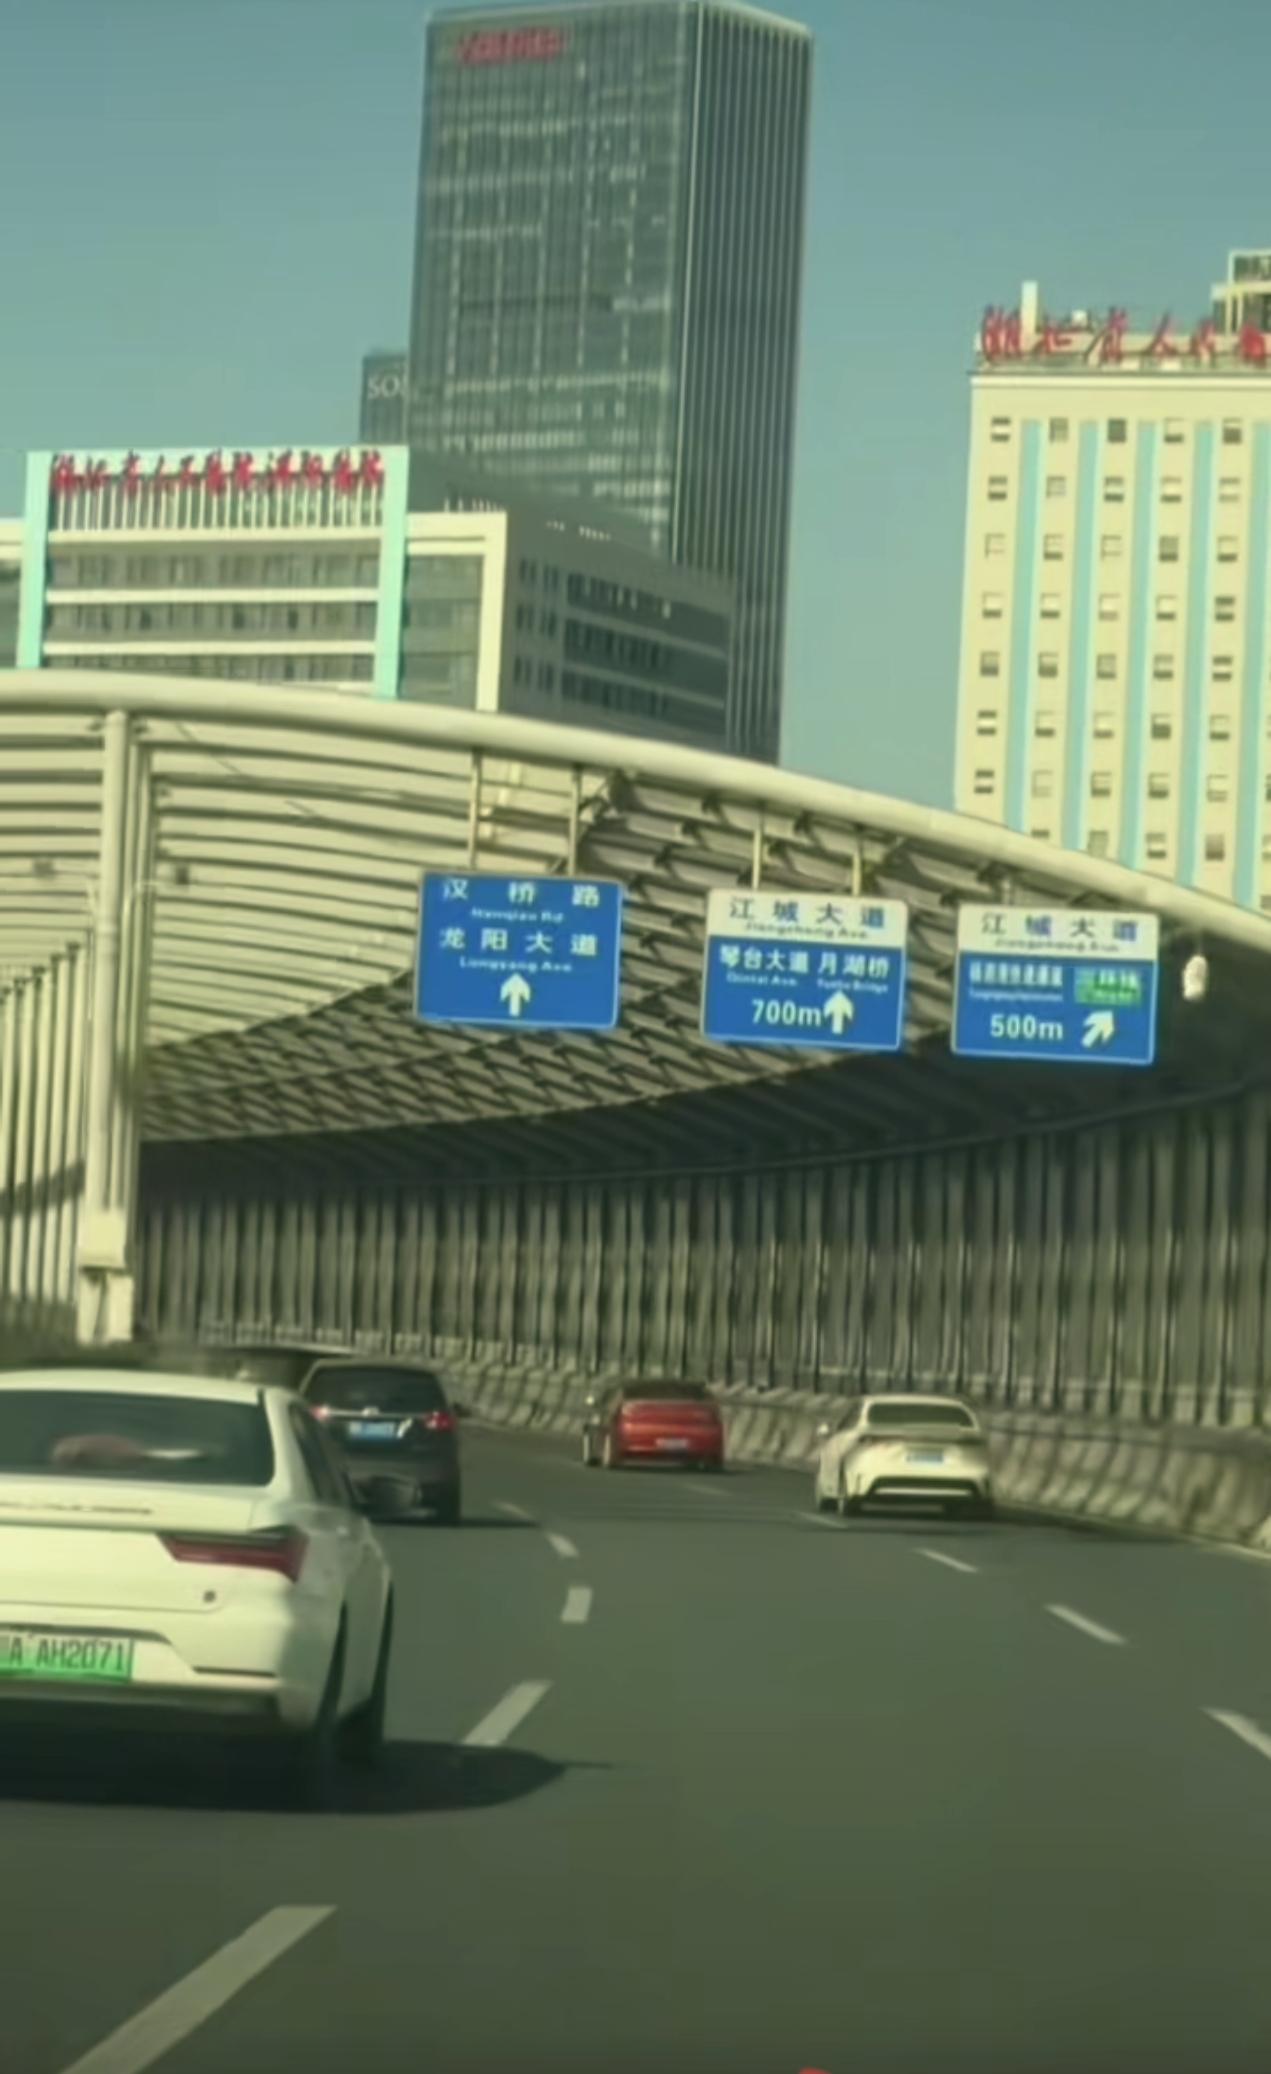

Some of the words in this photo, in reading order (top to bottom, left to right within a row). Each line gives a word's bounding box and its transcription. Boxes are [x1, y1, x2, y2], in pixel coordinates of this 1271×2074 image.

[730, 898, 884, 928] 江城大道
[440, 926, 598, 956] 龙阳大道
[752, 999, 822, 1027] 700m
[990, 1013, 1064, 1041] 500m
